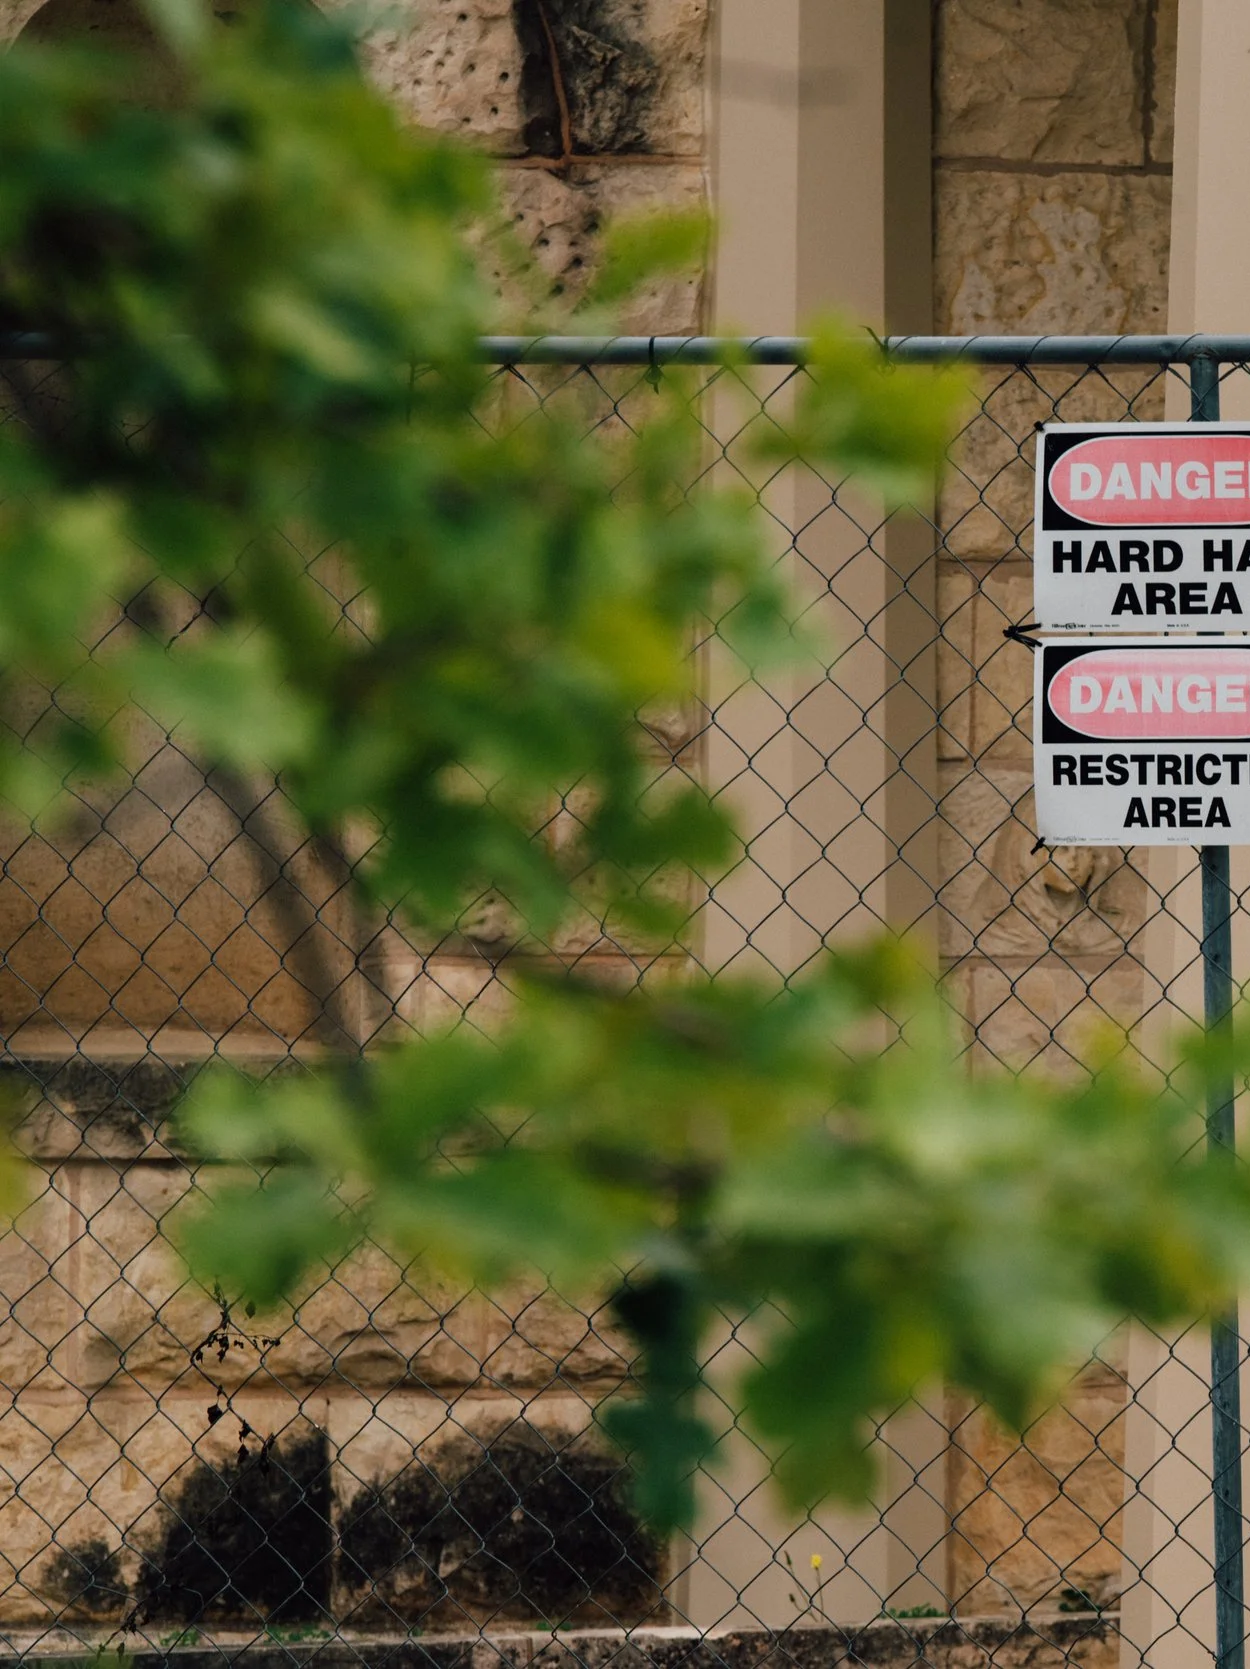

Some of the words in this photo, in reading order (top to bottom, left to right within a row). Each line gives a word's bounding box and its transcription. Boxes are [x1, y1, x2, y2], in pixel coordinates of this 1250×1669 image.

[1053, 540, 1184, 573] HARD
[1111, 582, 1243, 615] AREA
[1123, 797, 1231, 828] AREA
